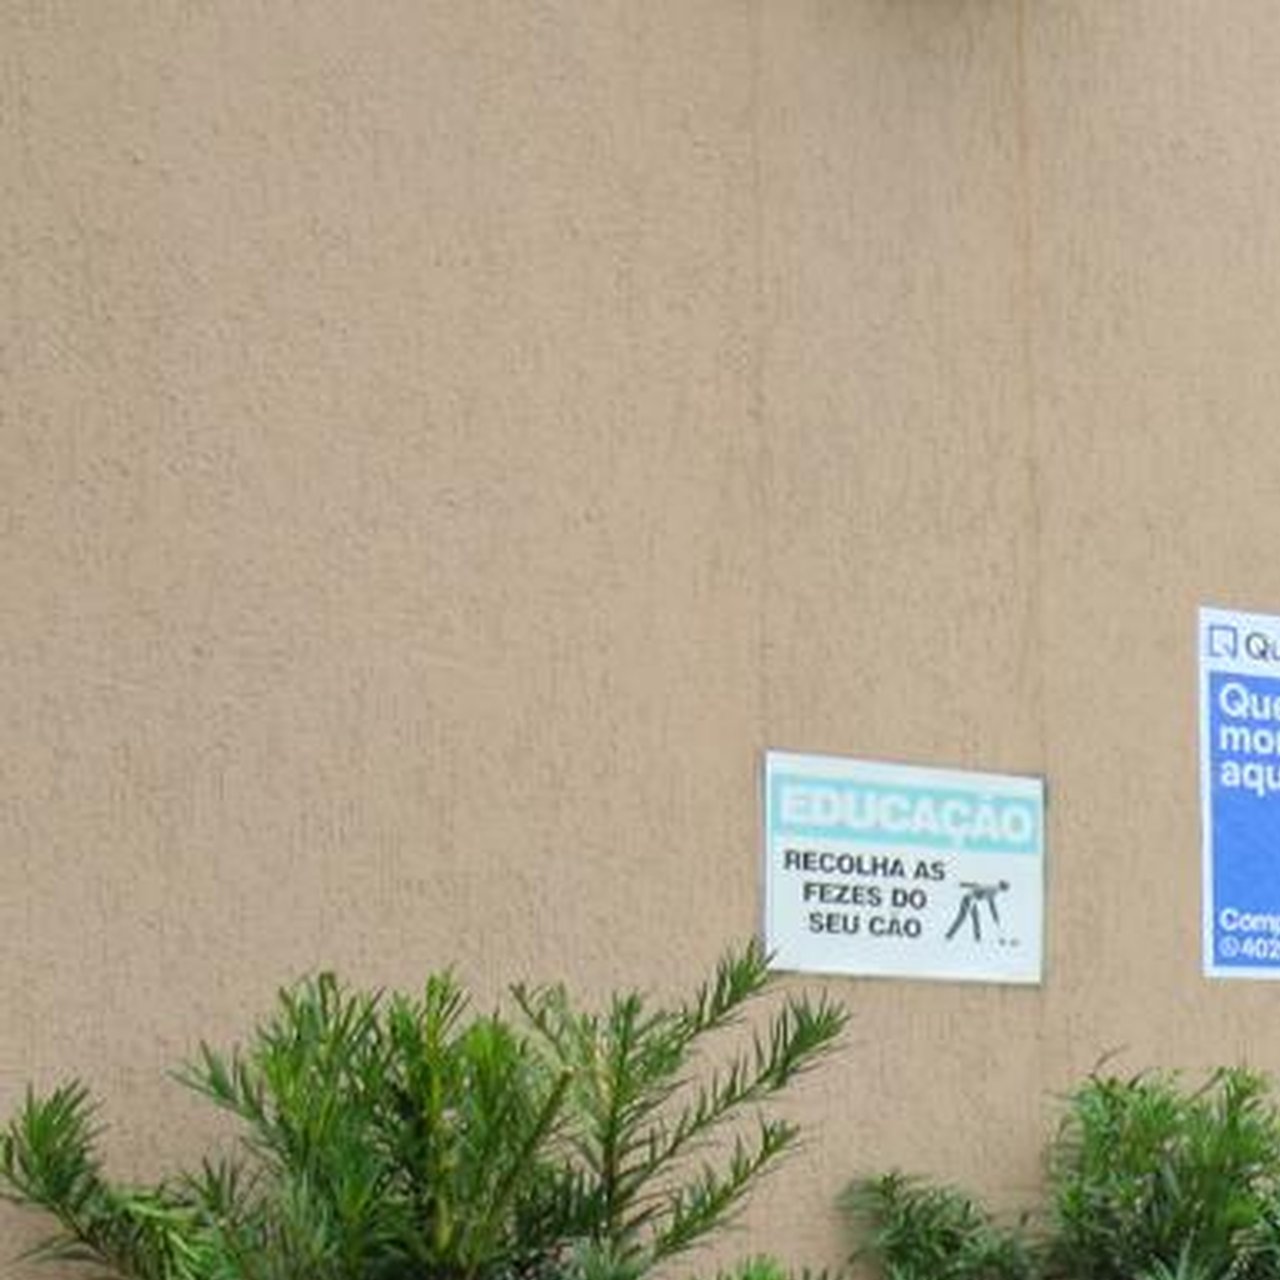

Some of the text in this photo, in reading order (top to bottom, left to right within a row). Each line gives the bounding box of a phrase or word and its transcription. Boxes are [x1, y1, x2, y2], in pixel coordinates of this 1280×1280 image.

[780, 784, 1033, 845] EDUCAÇÃO
[783, 850, 946, 881] RECOLHA AS
[803, 882, 928, 910] FEZES DO
[809, 911, 860, 935] SEU
